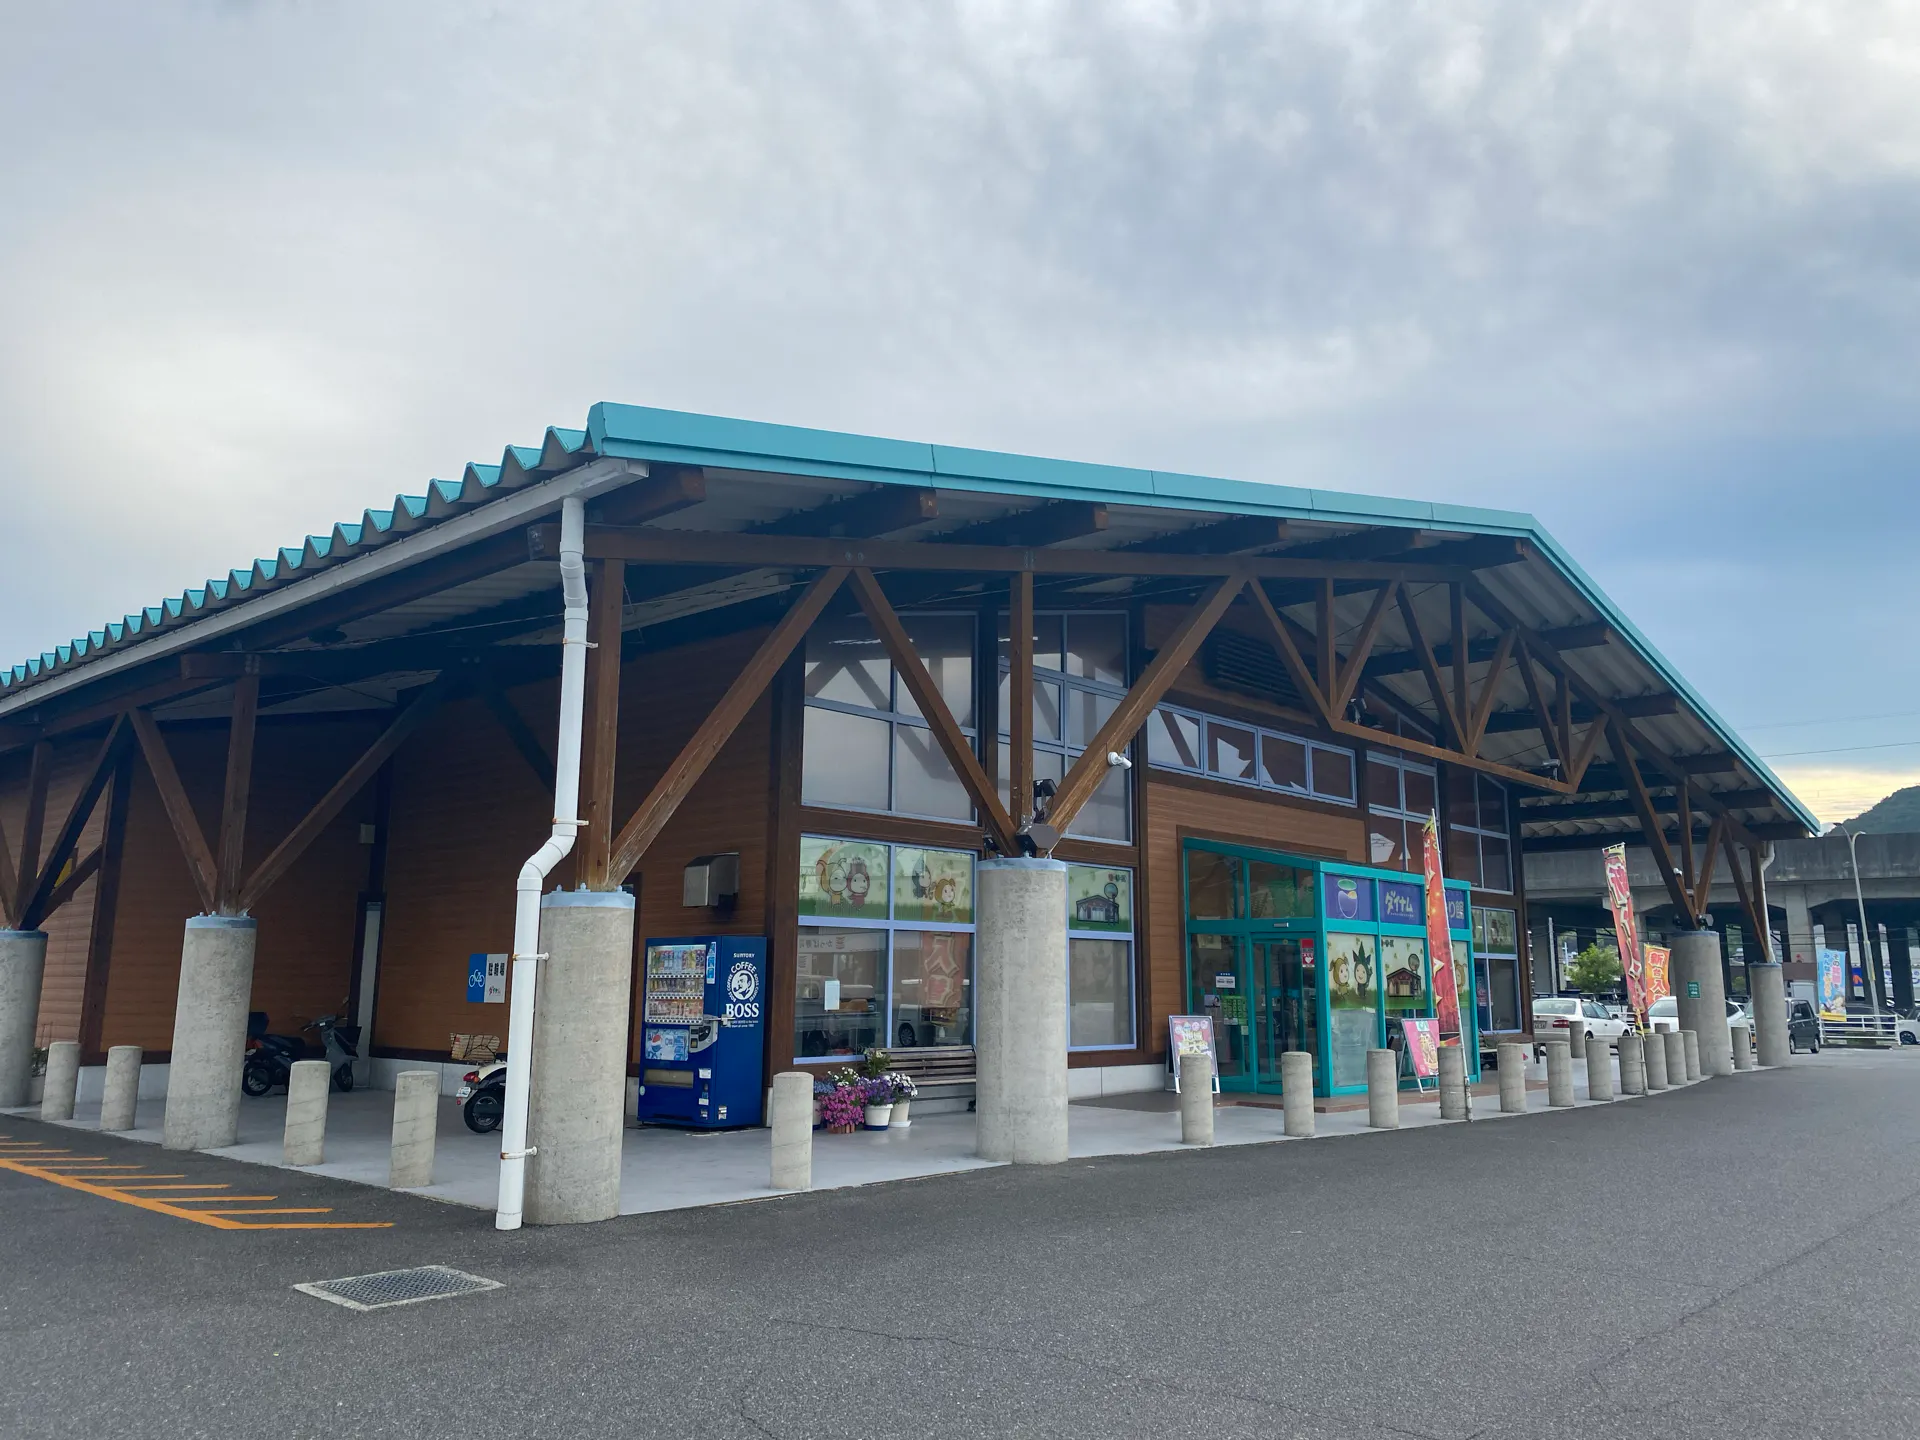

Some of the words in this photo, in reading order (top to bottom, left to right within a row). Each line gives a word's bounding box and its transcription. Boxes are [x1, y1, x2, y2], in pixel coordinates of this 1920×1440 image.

[1385, 890, 1414, 915] ダイナム
[1448, 900, 1465, 920] り館
[730, 961, 757, 974] COFFEE
[725, 1003, 759, 1018] BOSS
